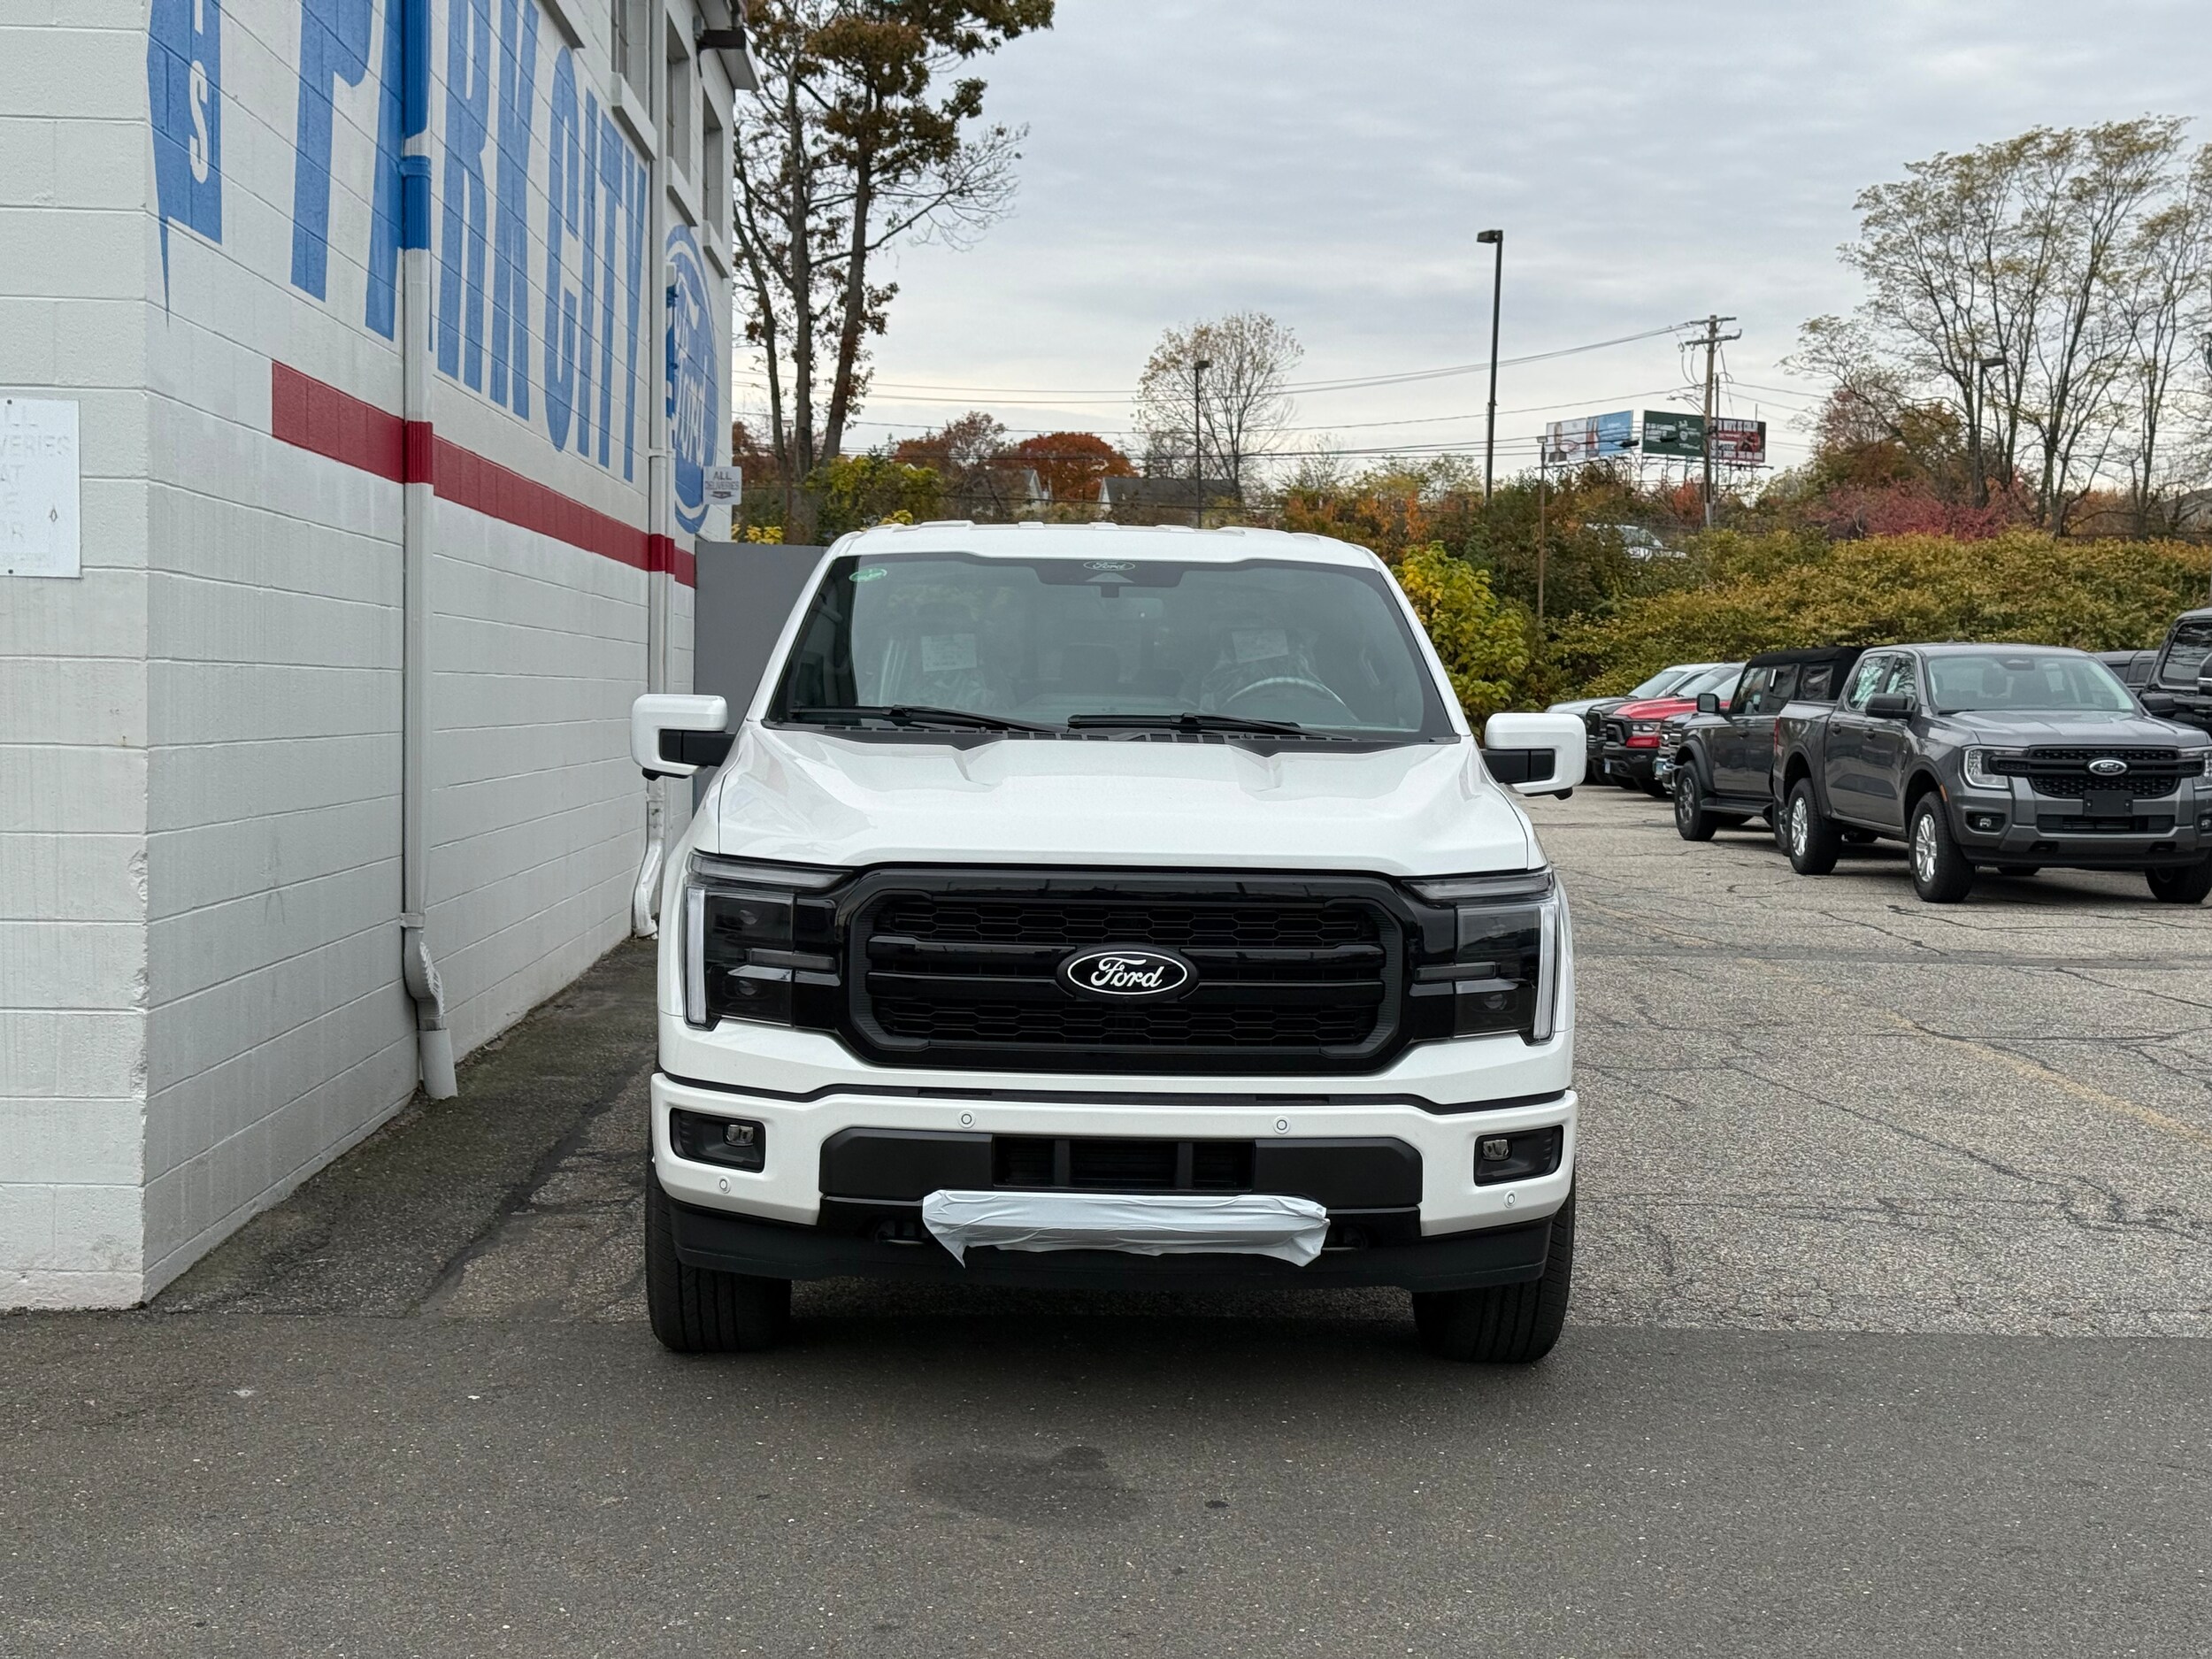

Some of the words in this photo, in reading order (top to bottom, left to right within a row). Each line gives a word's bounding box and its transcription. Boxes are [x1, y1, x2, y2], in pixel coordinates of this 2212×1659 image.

[713, 471, 733, 480] ALL
[1092, 561, 1126, 571] Ford
[1090, 956, 1164, 987] Ford
